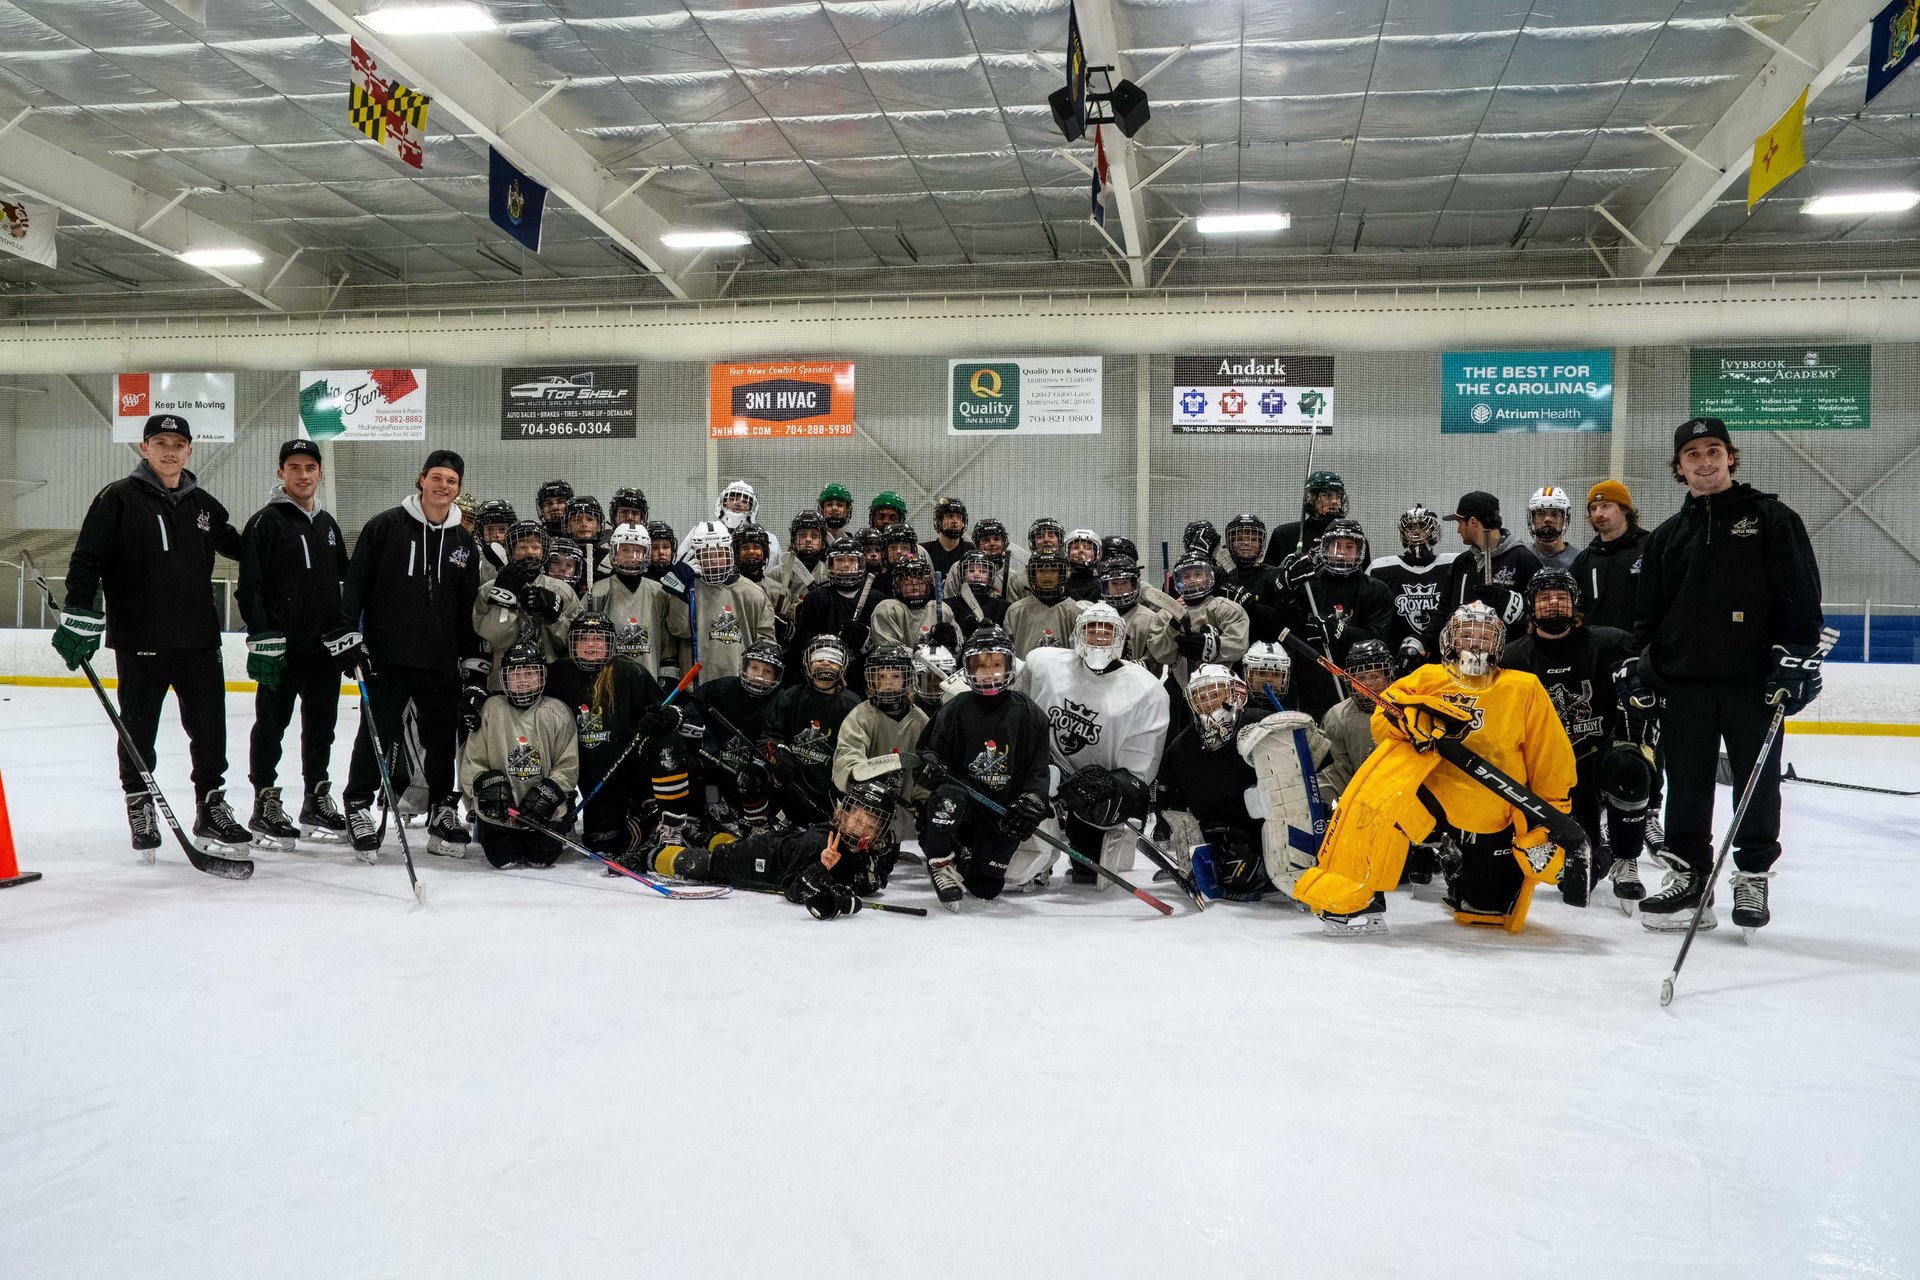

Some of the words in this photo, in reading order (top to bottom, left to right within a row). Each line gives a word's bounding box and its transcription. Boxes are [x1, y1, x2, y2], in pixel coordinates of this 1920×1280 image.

[1217, 358, 1287, 375] Andark
[1720, 358, 1786, 369] IVYBROOK
[729, 367, 744, 376] Your
[747, 366, 766, 375] Home
[768, 365, 797, 375] Comfort
[1022, 367, 1050, 376] Quality
[1073, 366, 1097, 374] Suites
[1463, 366, 1497, 379] THE
[1502, 365, 1548, 378] BEST
[1553, 365, 1590, 377] FOR
[1775, 368, 1838, 379] ACADEMY
[546, 389, 576, 399] TOP
[577, 388, 629, 399] SHELF
[1455, 383, 1490, 395] THE
[1495, 381, 1597, 395] CAROLINAS
[155, 401, 175, 410] Keep
[195, 400, 226, 410] Moving
[745, 392, 771, 409] 3N1
[777, 391, 817, 409] HVAC
[607, 409, 633, 417] DETAILING
[959, 402, 1013, 417] Quality
[1495, 408, 1538, 419] Atrium
[1540, 407, 1581, 419] Health
[520, 422, 611, 435] 704-966-0304
[1235, 426, 1323, 434] www.AndarkGraphics.cm
[1779, 656, 1822, 670] CC
[1546, 666, 1572, 674] CCM
[1049, 705, 1102, 745] ROYALS
[1572, 720, 1598, 733] READY
[865, 791, 882, 803] CCM
[1474, 765, 1548, 819] TRUE
[931, 817, 956, 826] CCM
